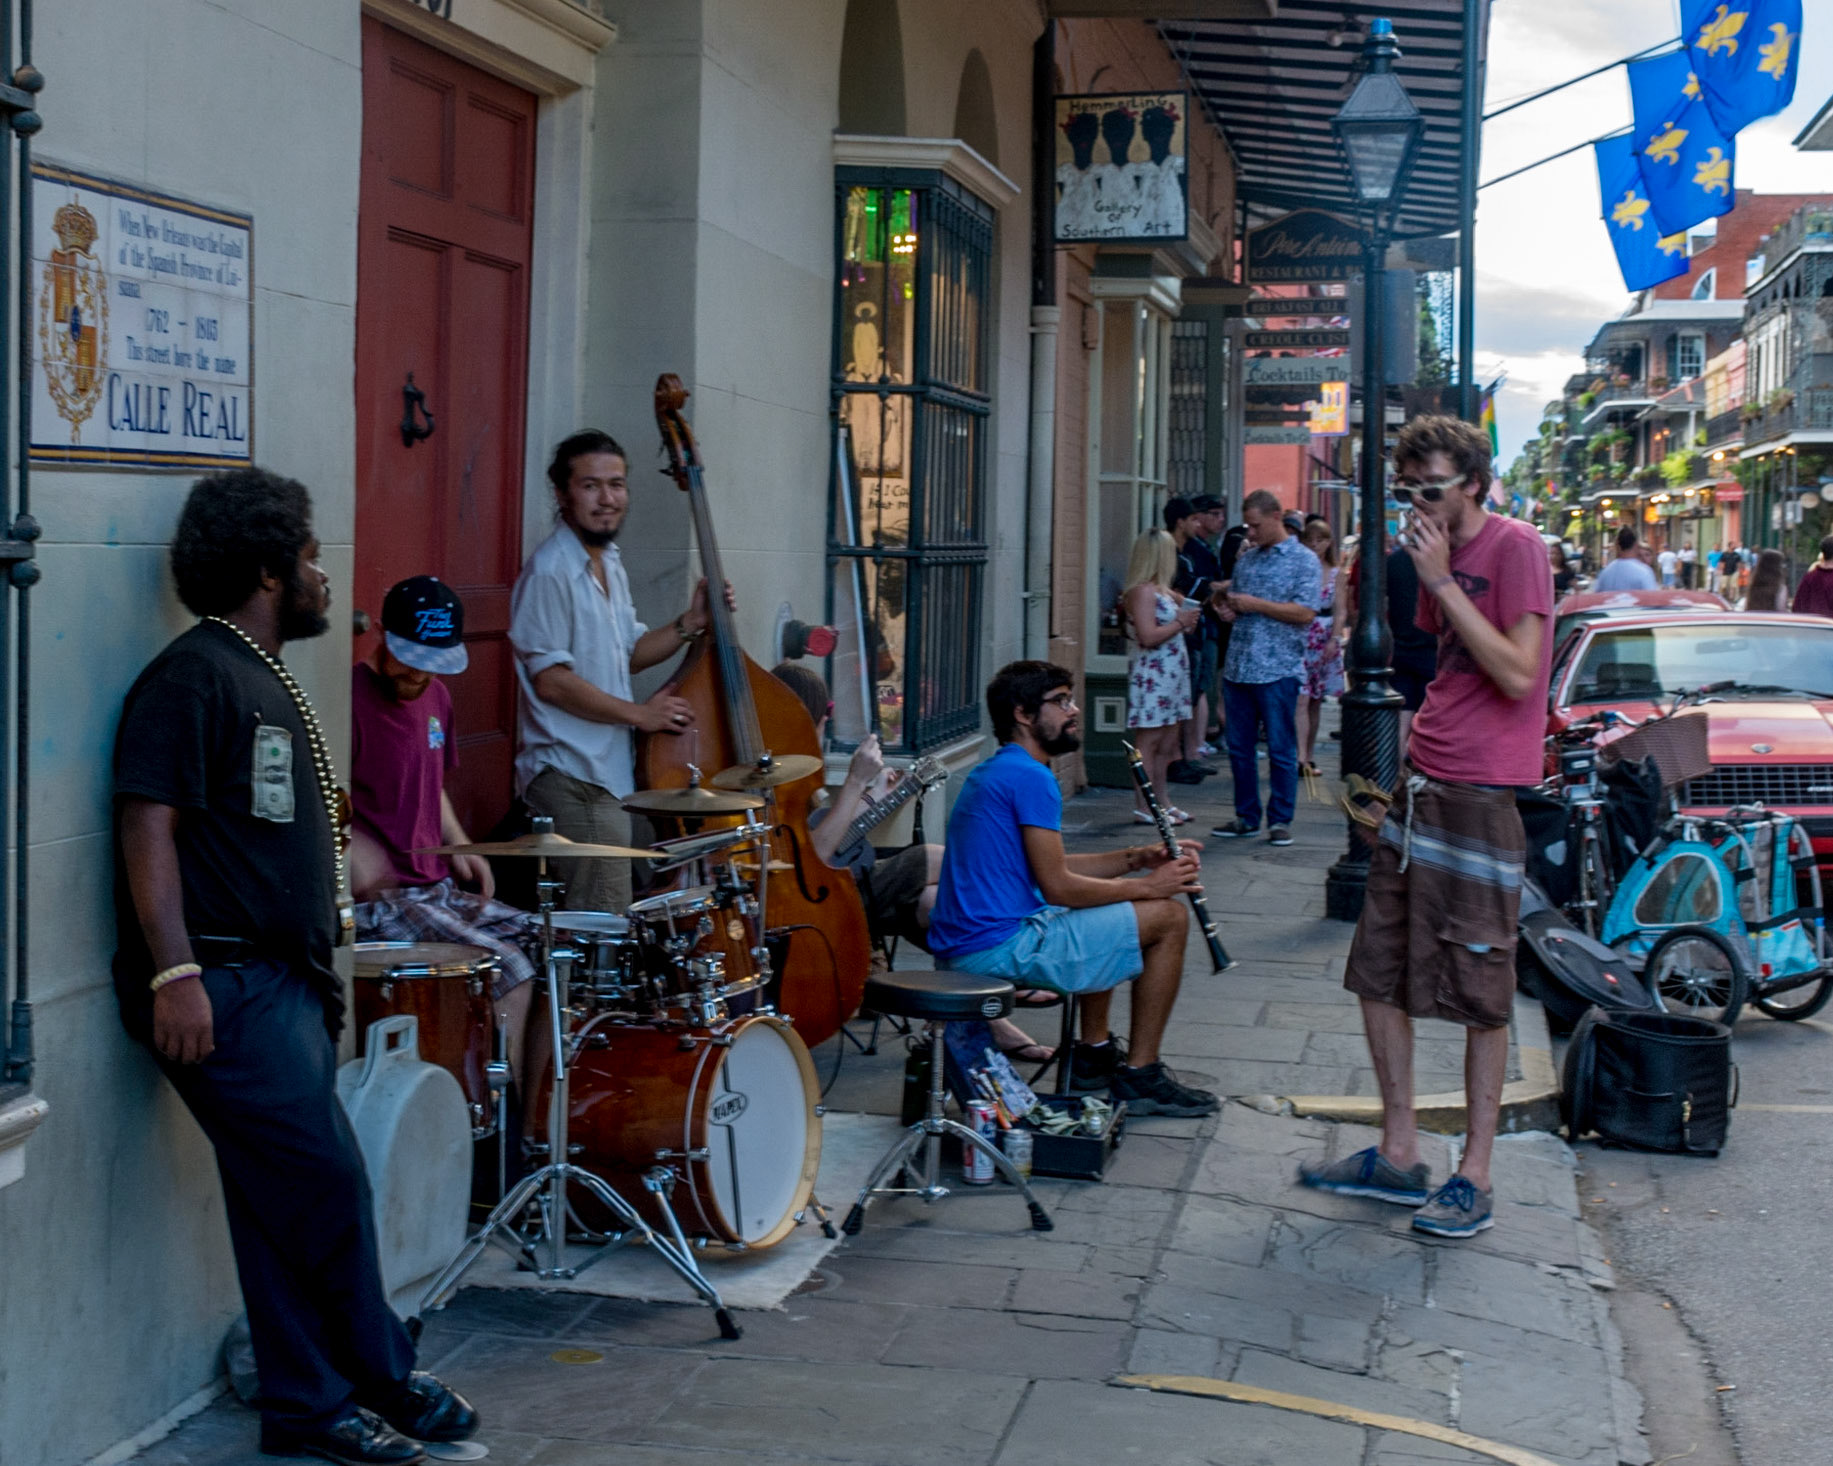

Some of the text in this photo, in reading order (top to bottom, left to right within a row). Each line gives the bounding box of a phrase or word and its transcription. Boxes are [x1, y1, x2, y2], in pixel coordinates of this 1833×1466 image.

[1094, 200, 1143, 218] Gallery
[119, 208, 141, 237] When
[141, 214, 159, 239] New
[1062, 220, 1172, 238] Southern Art
[1250, 266, 1327, 279] RESTAURANT
[126, 335, 143, 361] This
[145, 346, 171, 365] street
[196, 347, 210, 371] the
[1246, 365, 1322, 384] Cocktails
[109, 373, 245, 442] CALLE REAL
